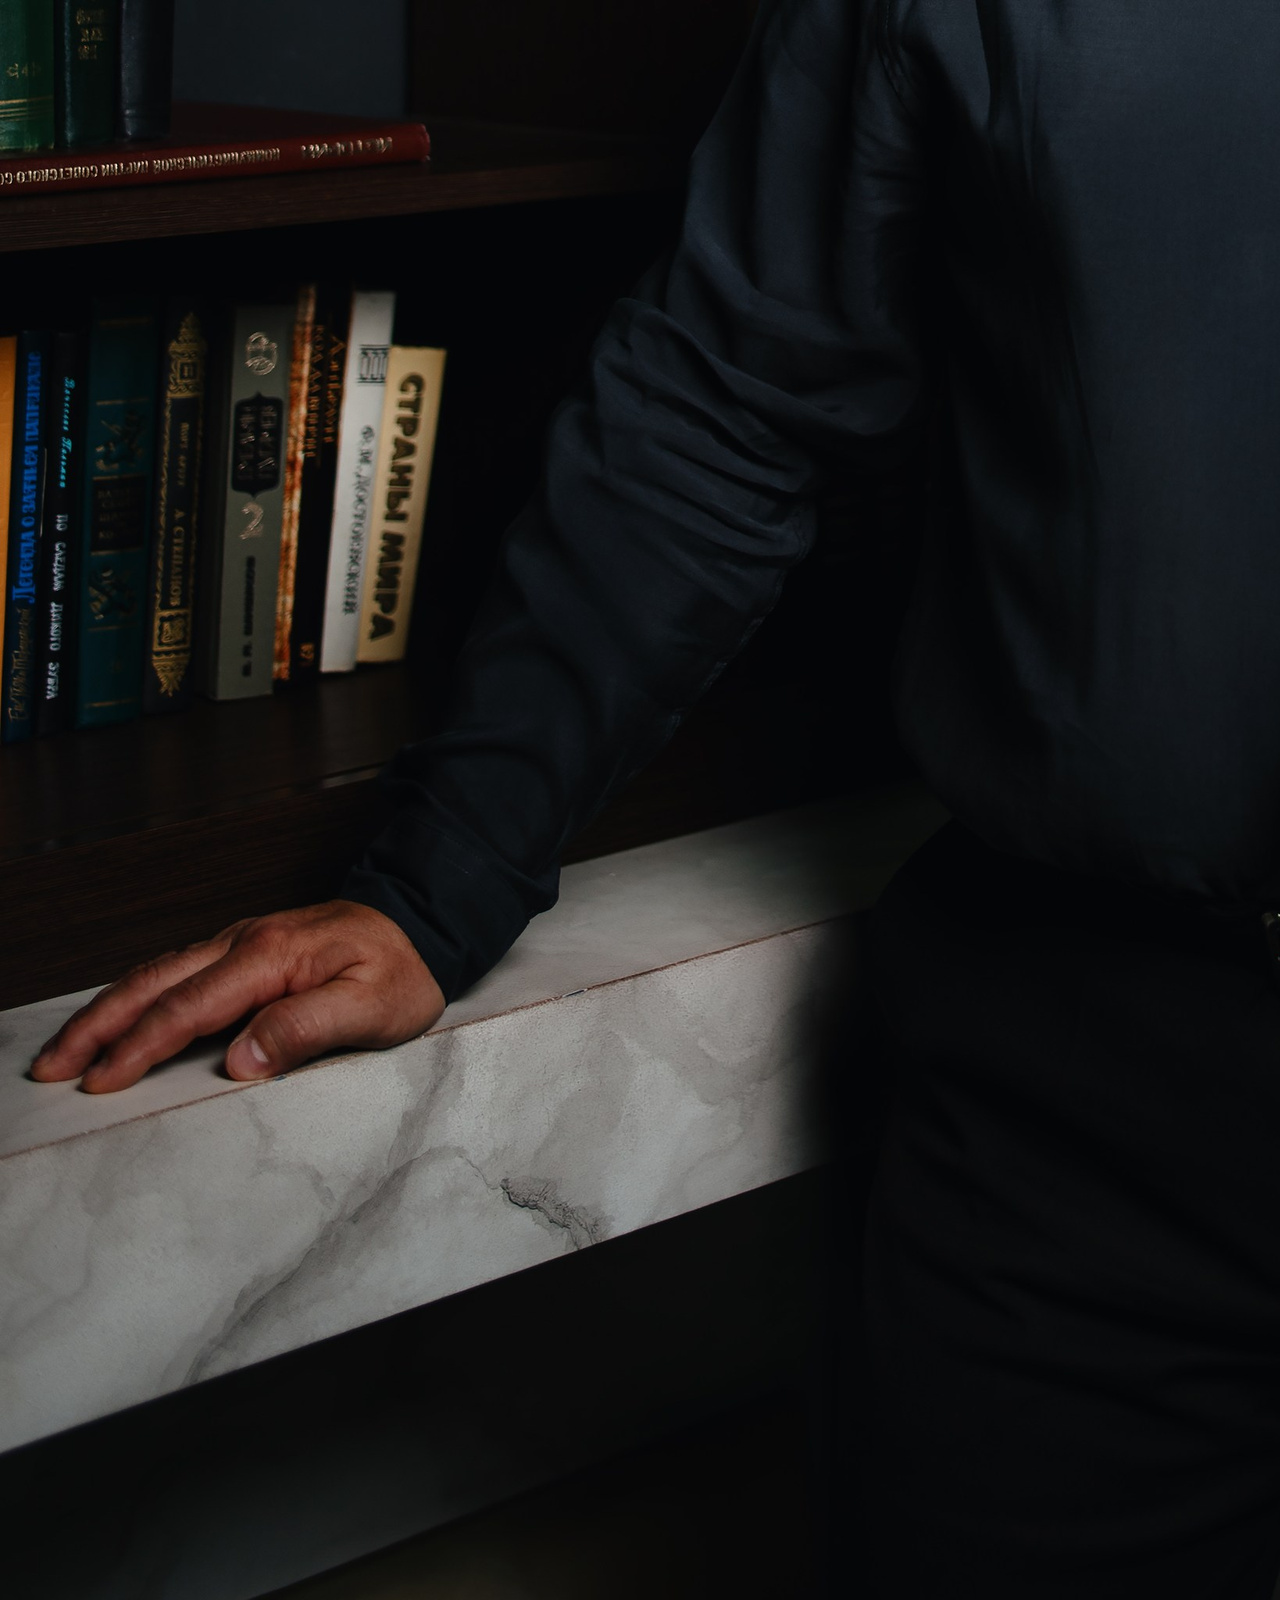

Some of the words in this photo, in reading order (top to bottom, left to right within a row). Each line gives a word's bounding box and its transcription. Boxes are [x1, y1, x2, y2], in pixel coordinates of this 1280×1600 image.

[16, 164, 98, 184] СОВЕТСКОГО
[100, 159, 149, 177] ПАРТИИ
[383, 372, 425, 523] СТРАНЫ
[54, 514, 68, 531] ПО
[240, 502, 264, 540] 2
[341, 471, 372, 616] ДОСТОЕВСКИЙ
[52, 542, 67, 592] СЛЕДАМ
[169, 525, 185, 606] СТЕПАНОВ
[367, 530, 406, 641] МИРА
[49, 601, 63, 651] ДИКОГО
